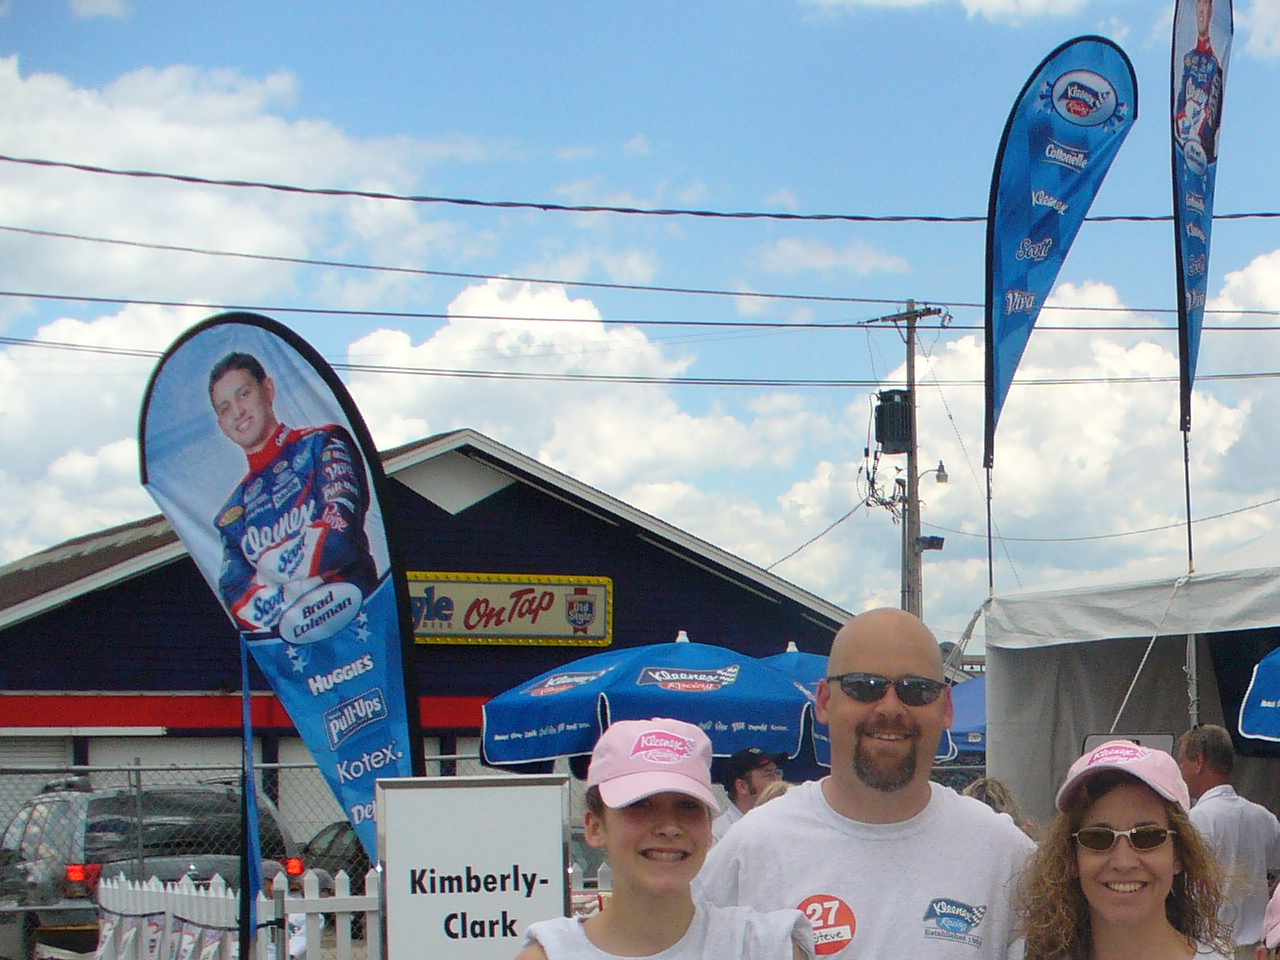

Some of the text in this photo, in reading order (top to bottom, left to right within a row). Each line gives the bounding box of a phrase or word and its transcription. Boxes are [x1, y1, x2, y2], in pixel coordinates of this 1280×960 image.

[1046, 144, 1088, 168] Cottonelle
[1031, 190, 1069, 215] Kleenex
[292, 595, 353, 638] Coleman
[302, 590, 335, 620] Brad
[463, 597, 506, 631] On
[508, 588, 555, 624] Tap
[567, 609, 596, 625] Style
[572, 601, 590, 612] Old
[648, 669, 720, 684] Kleenex
[640, 734, 687, 751] Kleenex
[409, 864, 550, 899] Kimberly-
[806, 900, 840, 928] 27
[933, 901, 974, 922] Kleenex
[443, 910, 519, 940] Clark
